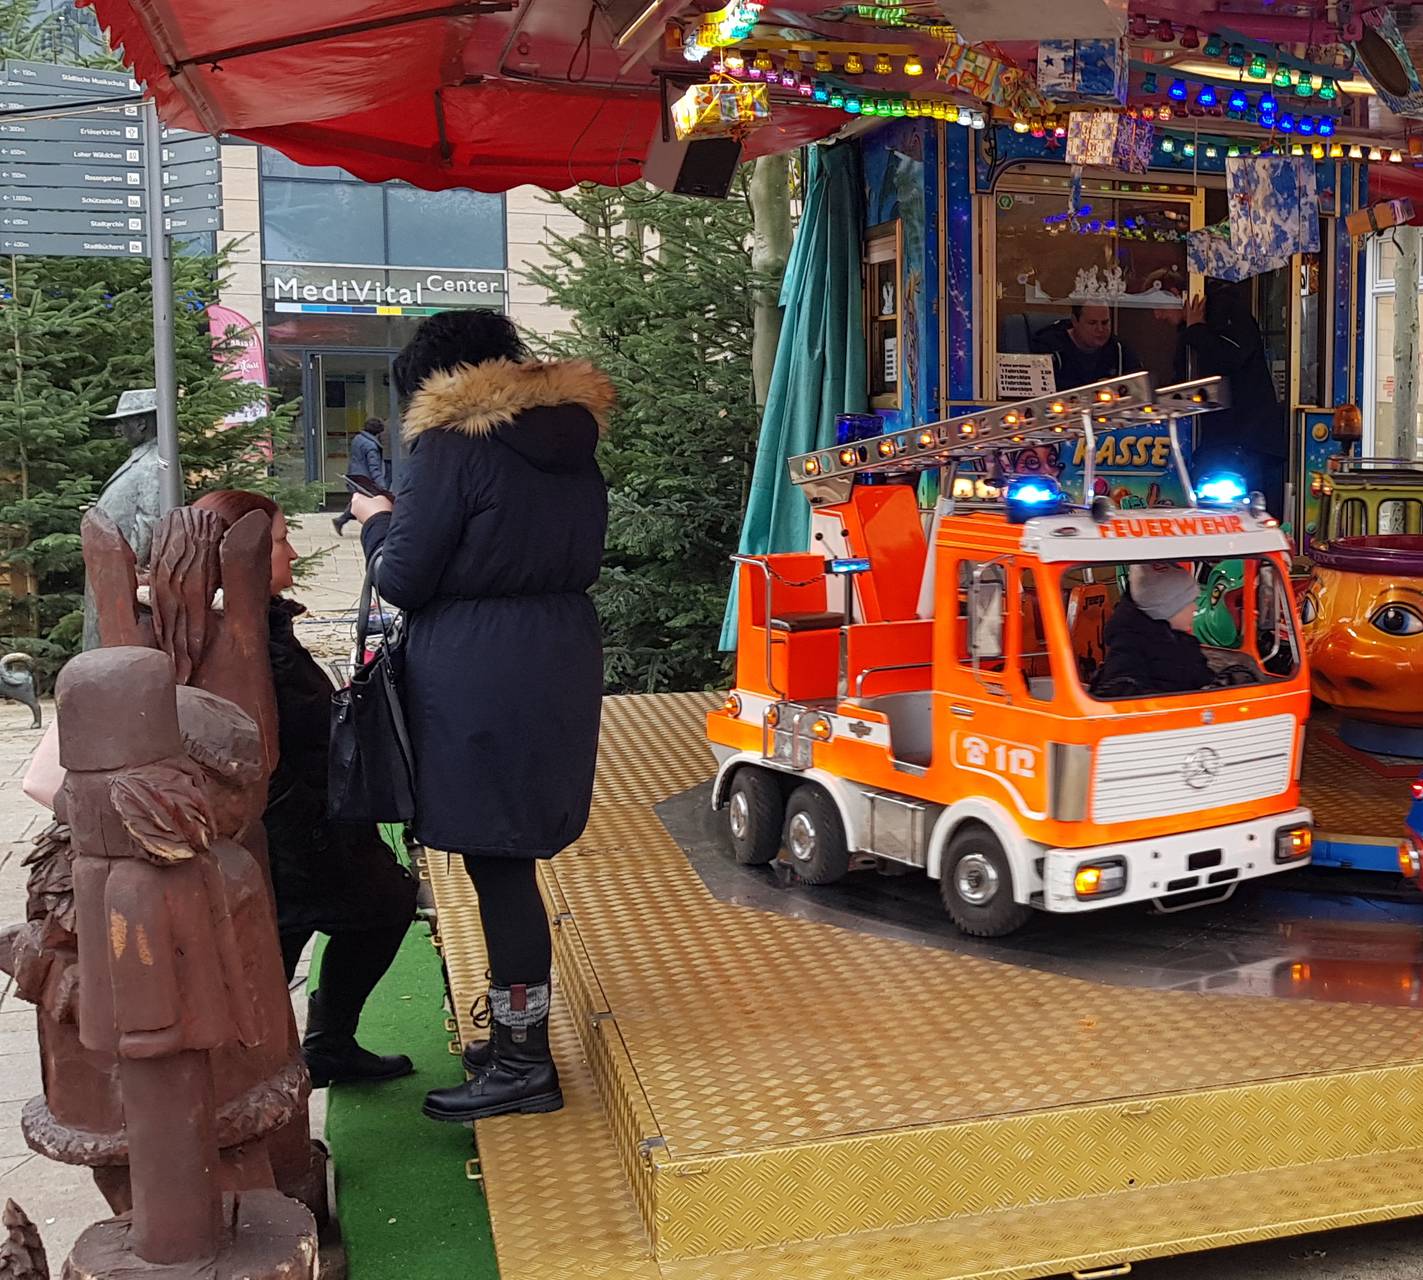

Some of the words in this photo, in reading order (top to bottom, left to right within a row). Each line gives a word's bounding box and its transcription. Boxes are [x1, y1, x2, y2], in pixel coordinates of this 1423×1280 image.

[273, 276, 423, 306] MediVital
[426, 274, 500, 295] Center
[1072, 435, 1171, 467] KASSE
[1096, 515, 1245, 539] FEUERWEHR
